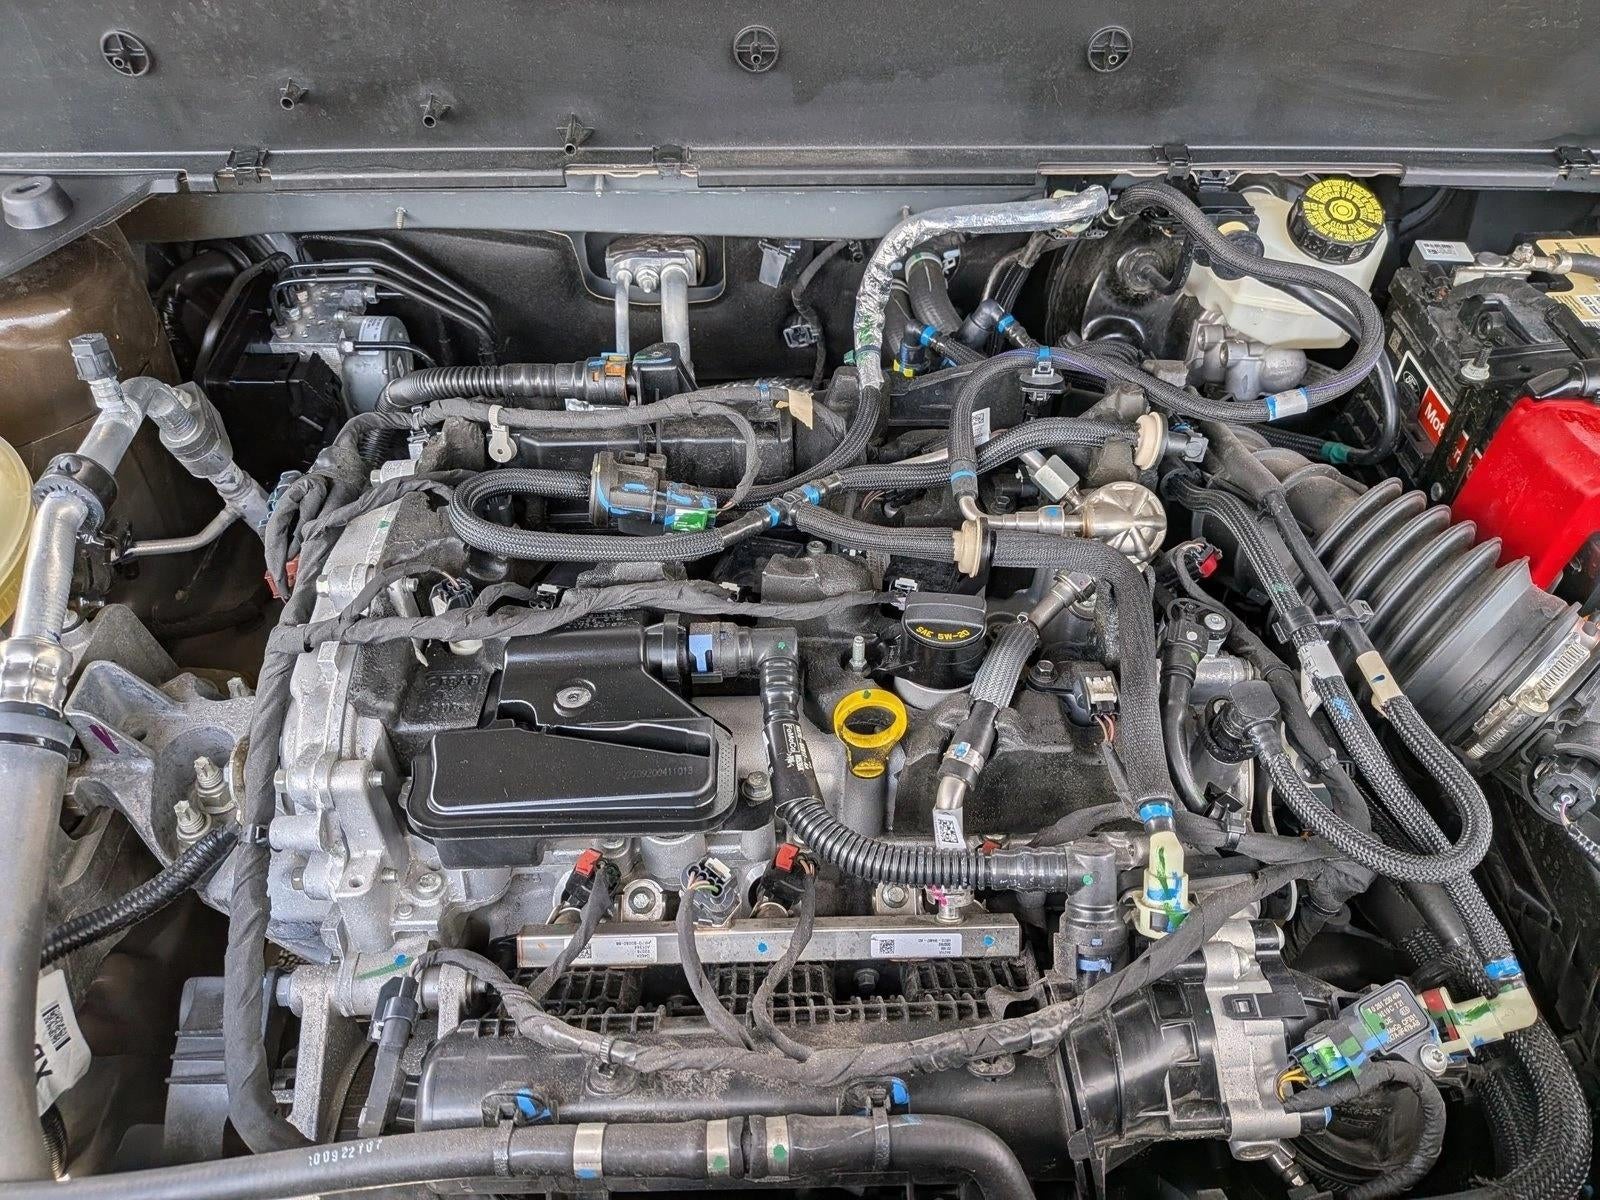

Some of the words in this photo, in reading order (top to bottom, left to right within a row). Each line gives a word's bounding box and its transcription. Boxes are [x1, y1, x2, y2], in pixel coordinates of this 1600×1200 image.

[916, 626, 934, 638] SAE
[937, 629, 970, 640] 5W-20
[786, 723, 797, 752] FoMoCo
